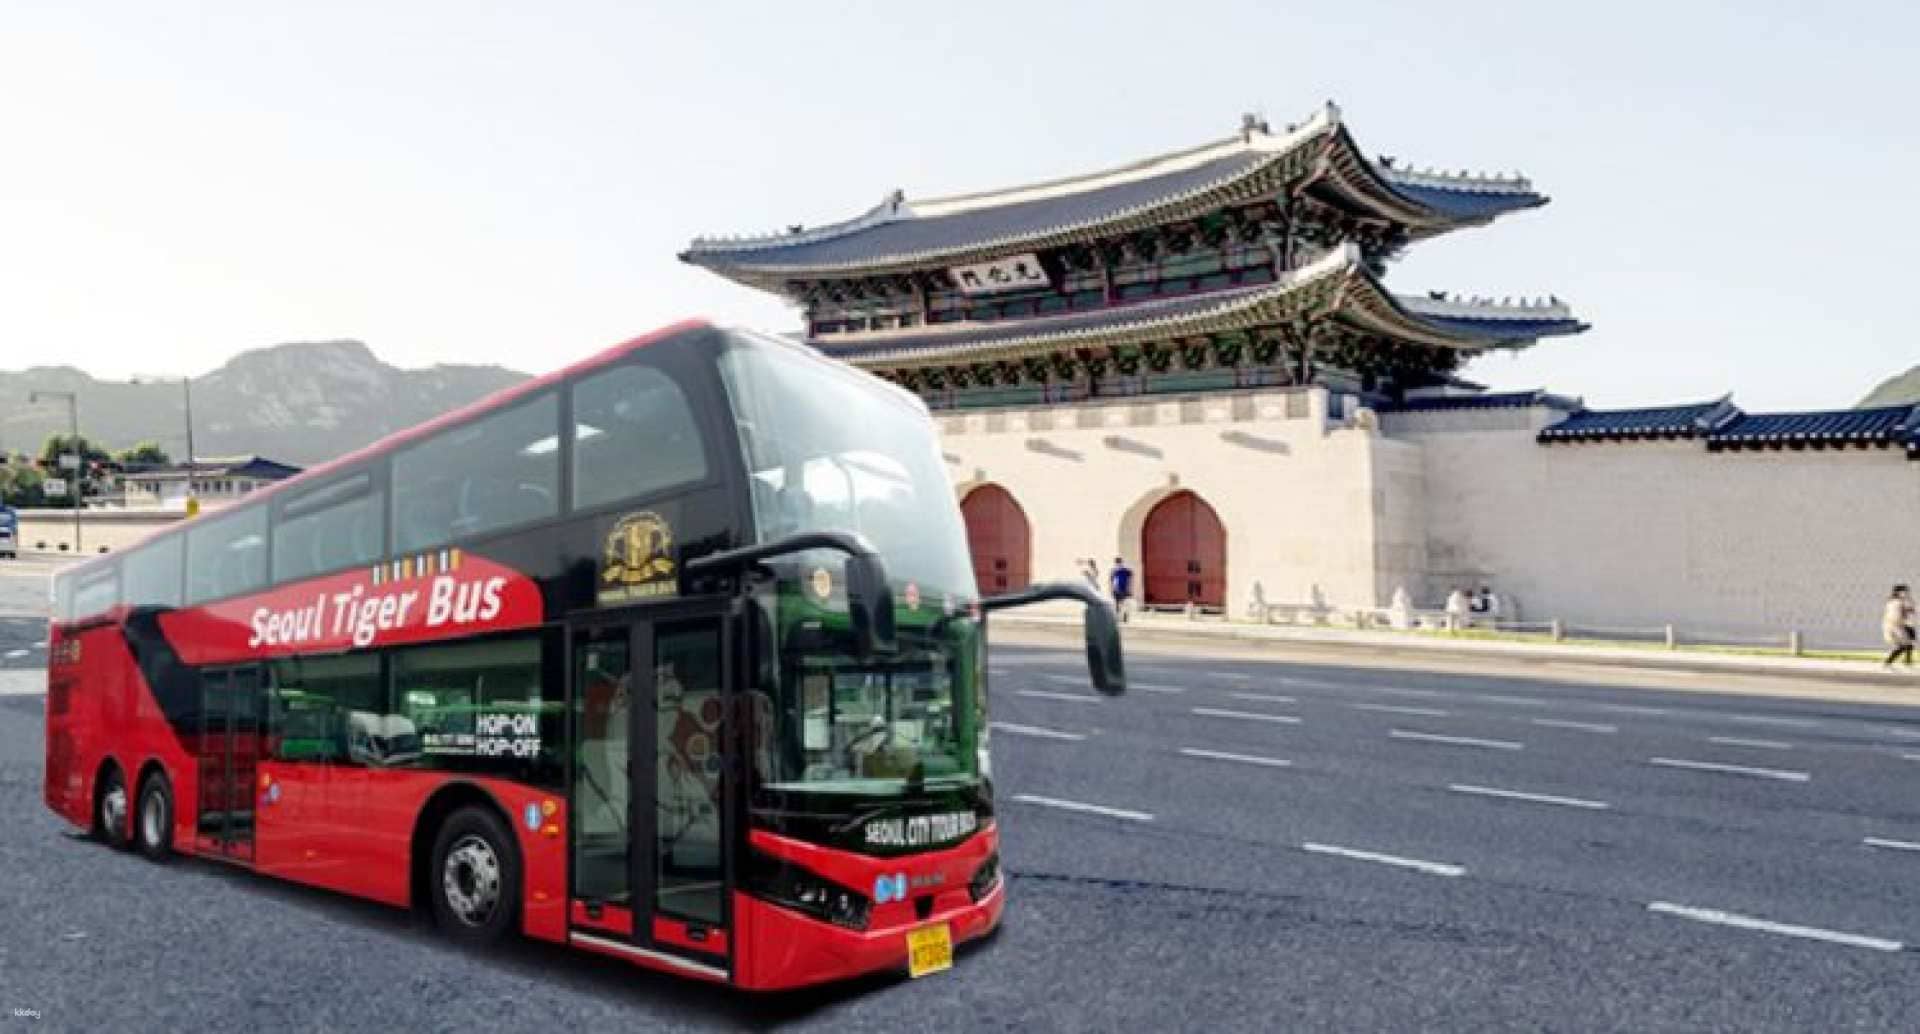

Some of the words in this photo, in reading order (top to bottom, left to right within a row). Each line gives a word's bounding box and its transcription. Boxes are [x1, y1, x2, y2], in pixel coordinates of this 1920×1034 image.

[249, 593, 325, 648] Seoul
[332, 584, 418, 647] Tiger
[426, 576, 508, 626] Bus
[475, 713, 537, 735] HOP-ON
[475, 738, 542, 757] HOP-OFF
[865, 819, 905, 845] SEOUL
[908, 815, 930, 845] CITY
